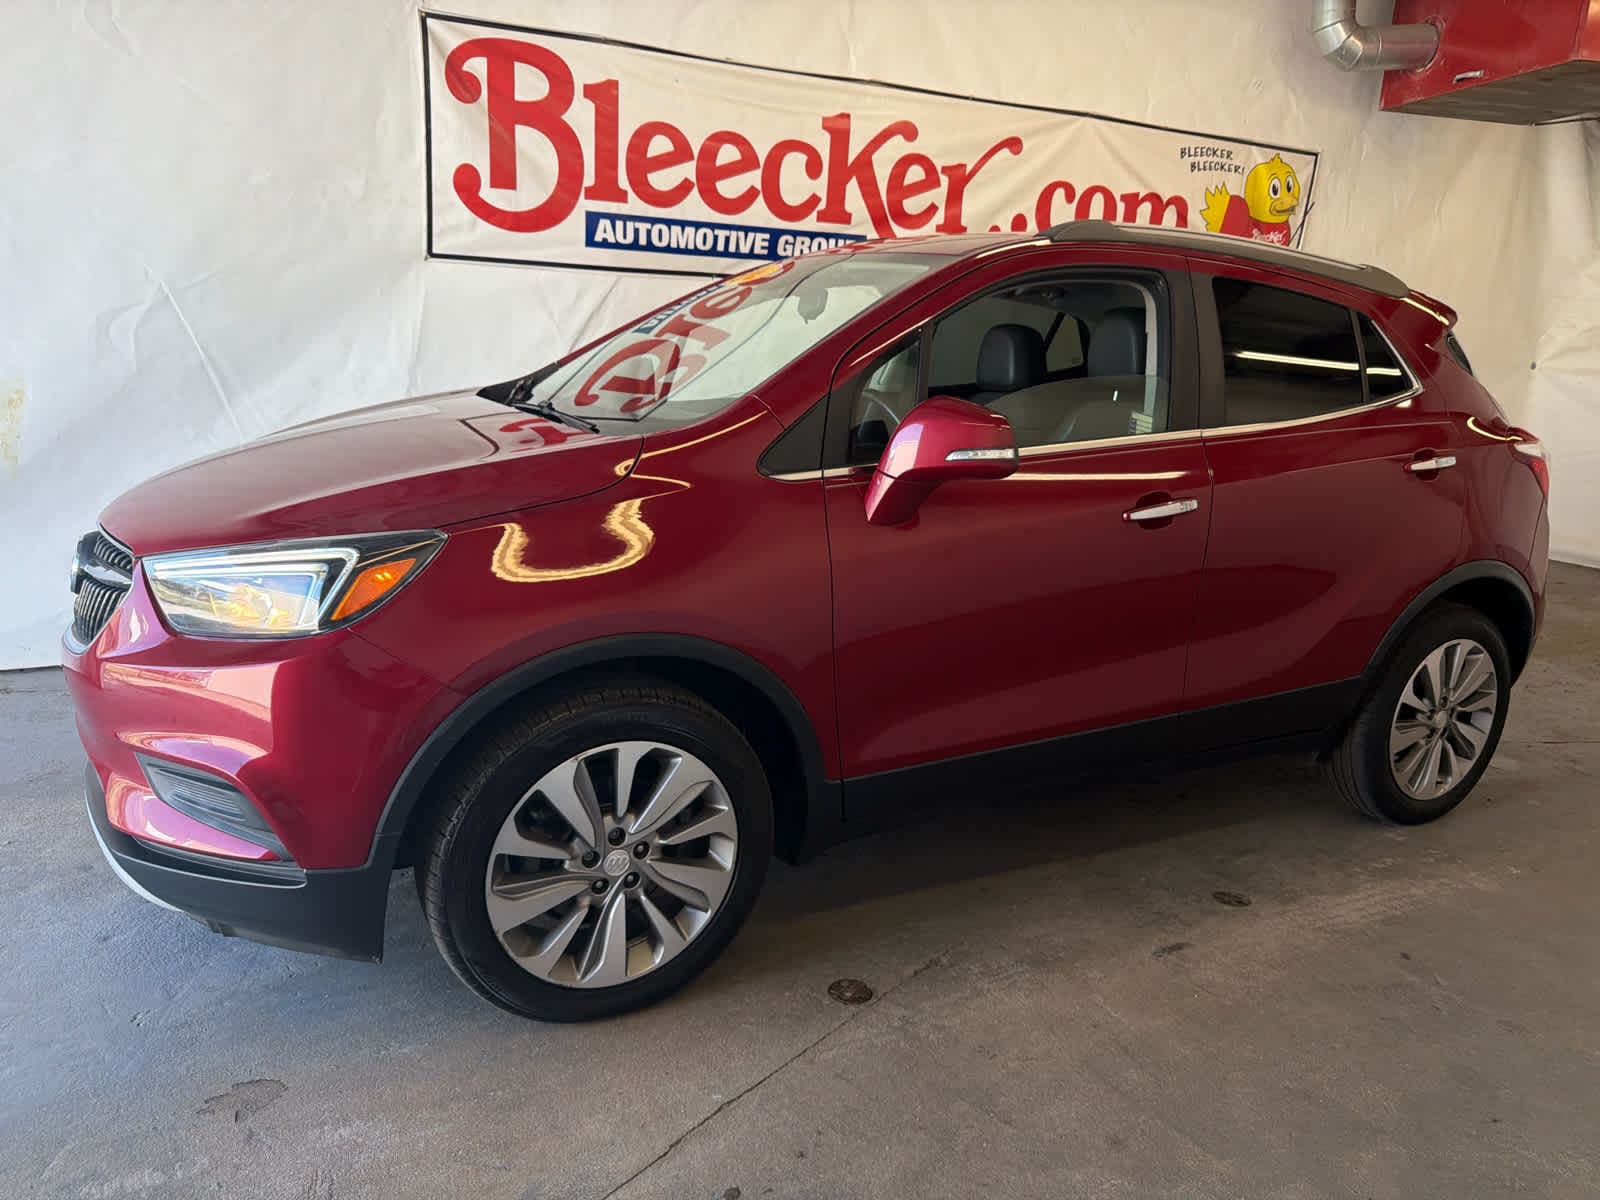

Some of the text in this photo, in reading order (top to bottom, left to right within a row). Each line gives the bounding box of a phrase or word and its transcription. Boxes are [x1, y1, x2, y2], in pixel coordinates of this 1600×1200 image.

[1179, 145, 1233, 160] BLEECKER
[1190, 160, 1246, 176] BLEECKER!
[593, 218, 857, 257] AUTOMOTIVE GRO
